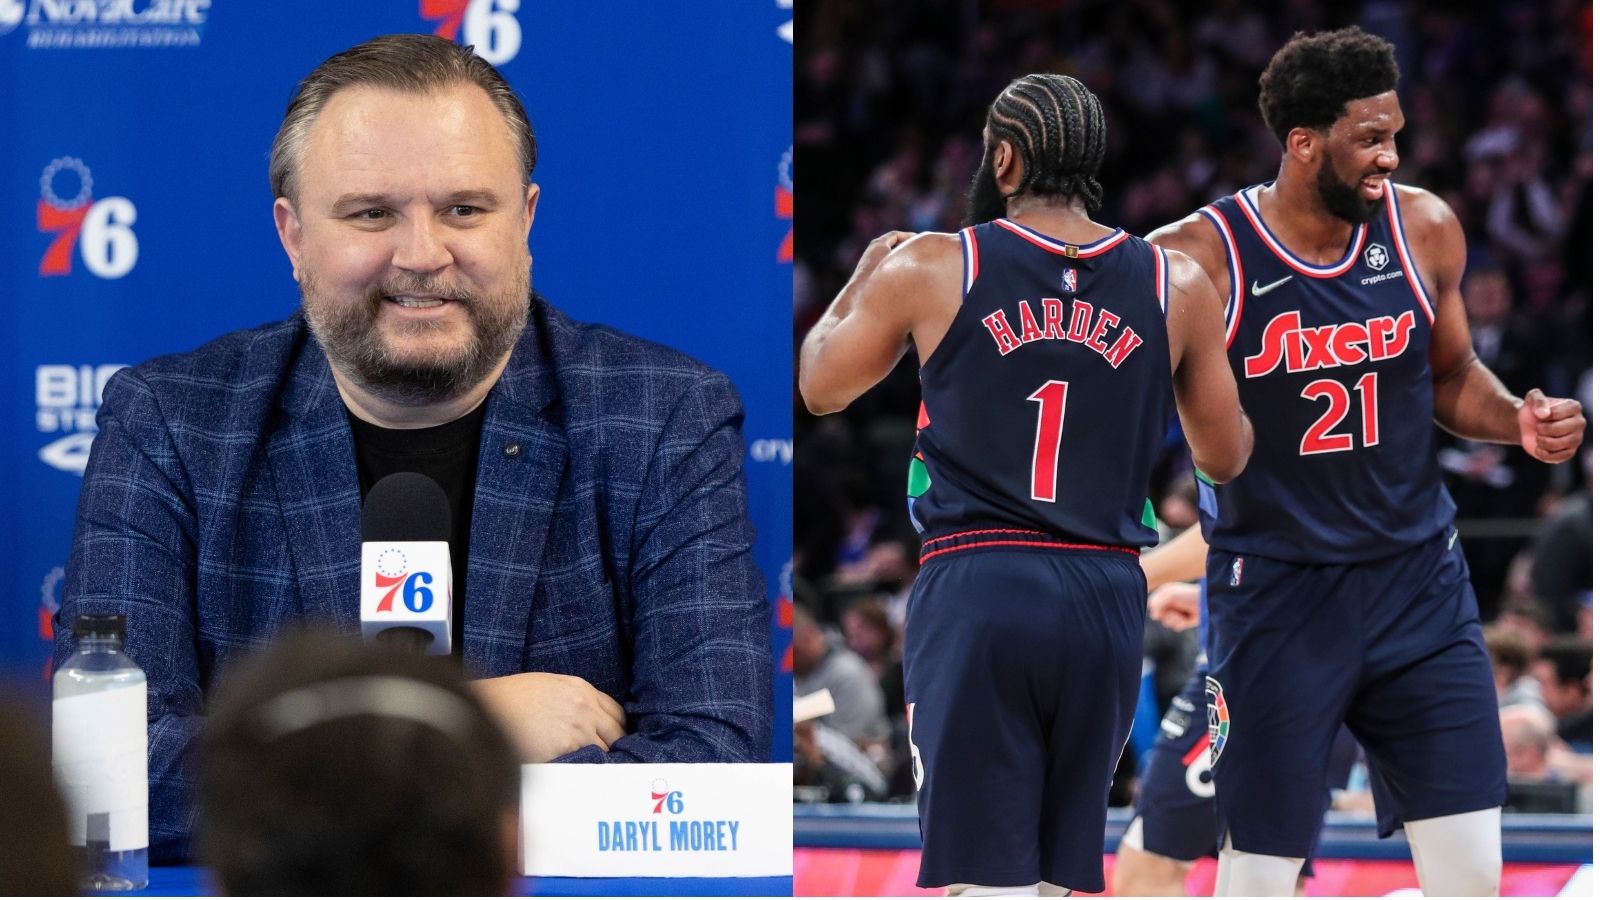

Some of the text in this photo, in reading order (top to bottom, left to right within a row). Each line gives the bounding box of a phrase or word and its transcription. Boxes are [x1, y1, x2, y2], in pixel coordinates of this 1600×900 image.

[38, 196, 138, 279] 76
[1361, 271, 1403, 285] crypto.com
[982, 298, 1143, 369] HARDEN
[1244, 310, 1416, 378] Sixers
[1026, 380, 1068, 503] 1
[1300, 372, 1379, 456] 21
[376, 572, 433, 613] 76
[598, 820, 739, 851] DARYL MOREY
[652, 791, 684, 814] 76
